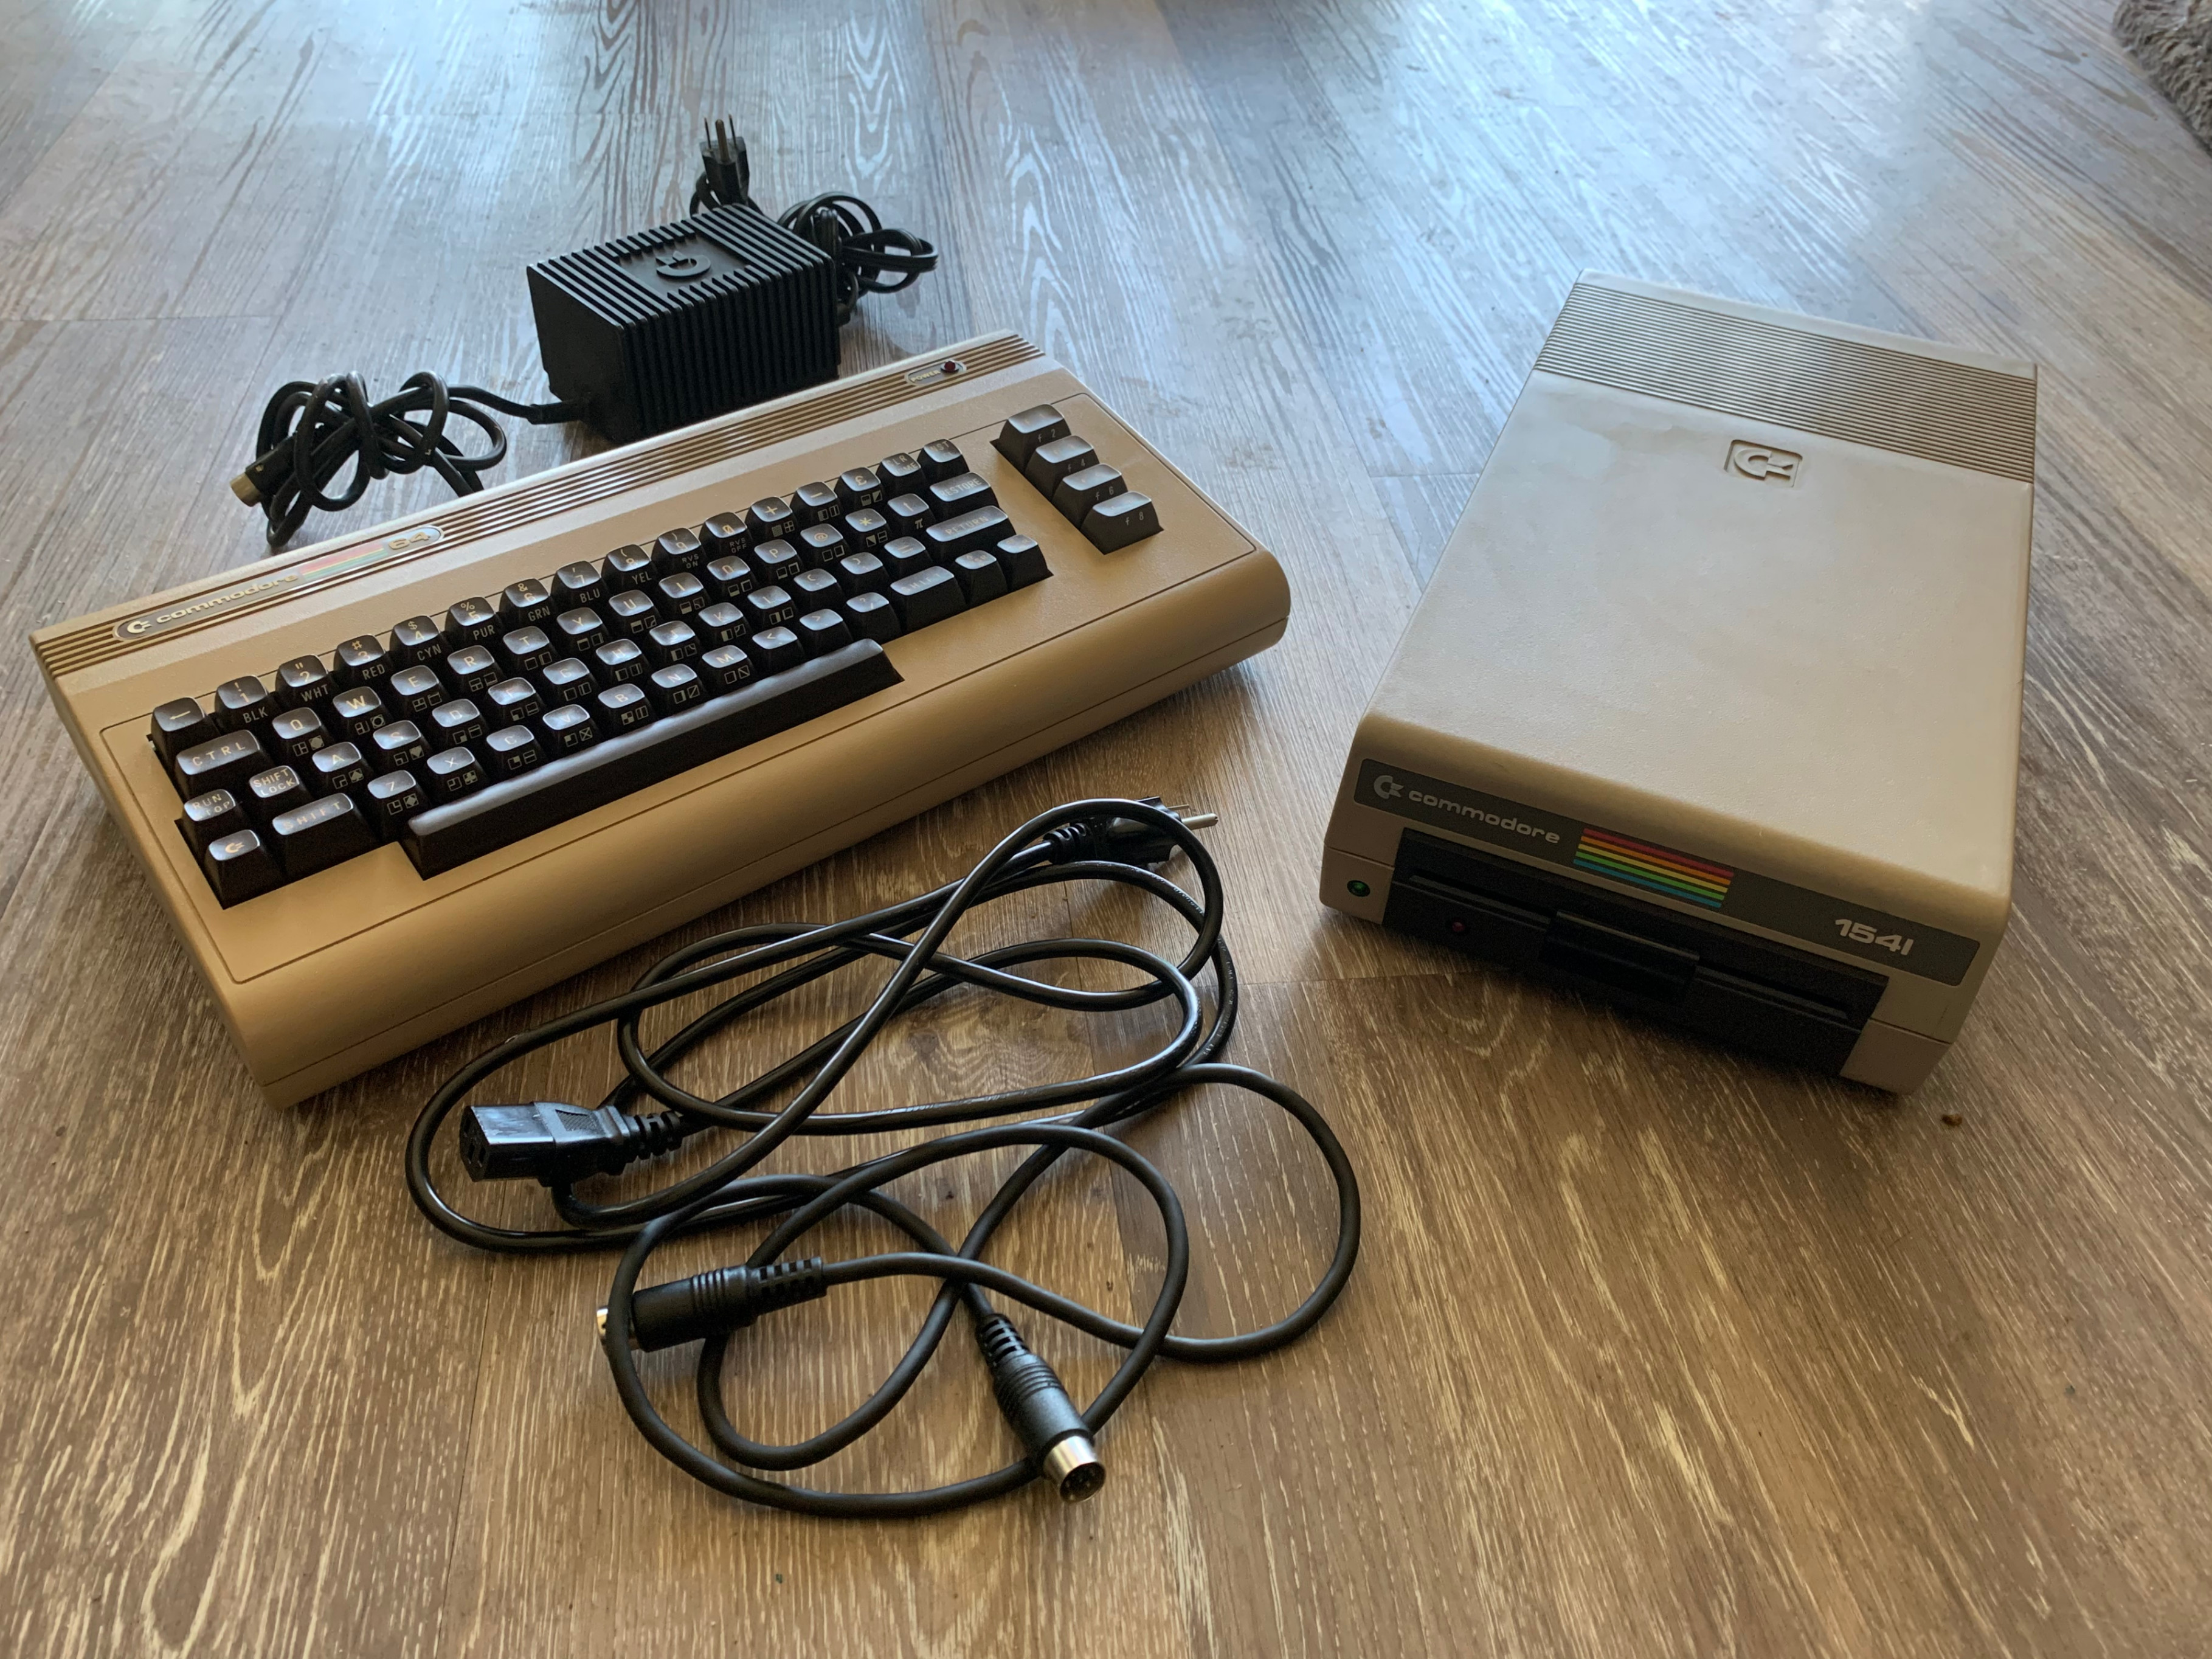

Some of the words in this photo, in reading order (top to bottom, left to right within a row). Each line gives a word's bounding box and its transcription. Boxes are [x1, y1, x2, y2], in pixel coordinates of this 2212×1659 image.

[911, 370, 941, 383] POWER
[940, 478, 982, 496] RESTORE
[945, 515, 989, 535] RETURN
[814, 532, 828, 541] @
[730, 538, 746, 547] RVS
[731, 544, 747, 554] OFF
[769, 548, 779, 558] P
[682, 554, 699, 563] RVS
[156, 574, 299, 624] commodore
[389, 532, 431, 550] 64
[575, 574, 586, 584] 7
[632, 570, 652, 585] YEL
[524, 592, 536, 602] 6
[579, 588, 601, 603] BLU
[460, 602, 475, 611] %
[623, 599, 637, 609] U
[468, 611, 481, 621] 5
[528, 606, 551, 622] GRN
[713, 611, 725, 622] K
[408, 621, 418, 630] $
[572, 616, 584, 626] Y
[473, 625, 496, 640] PUR
[519, 636, 531, 646] T
[358, 651, 370, 660] 3
[417, 643, 442, 661] CYN
[463, 656, 476, 667] R
[716, 653, 734, 664] M
[362, 663, 385, 681] RED
[408, 676, 421, 688] E
[668, 673, 682, 683] N
[301, 684, 330, 702] WHT
[615, 694, 629, 703] B
[346, 695, 365, 710] W
[243, 707, 268, 724] BLK
[449, 710, 463, 721] D
[504, 736, 517, 745] C
[192, 742, 246, 767] CTRL
[332, 754, 345, 765] A
[444, 757, 458, 767] X
[253, 768, 289, 788] SHIFT
[260, 779, 296, 797] LOCK
[192, 793, 222, 809] RUN
[197, 800, 230, 820] TOP
[283, 802, 340, 830] SHIFT
[1408, 790, 1561, 844] commodore
[1834, 918, 1914, 956] 1541
